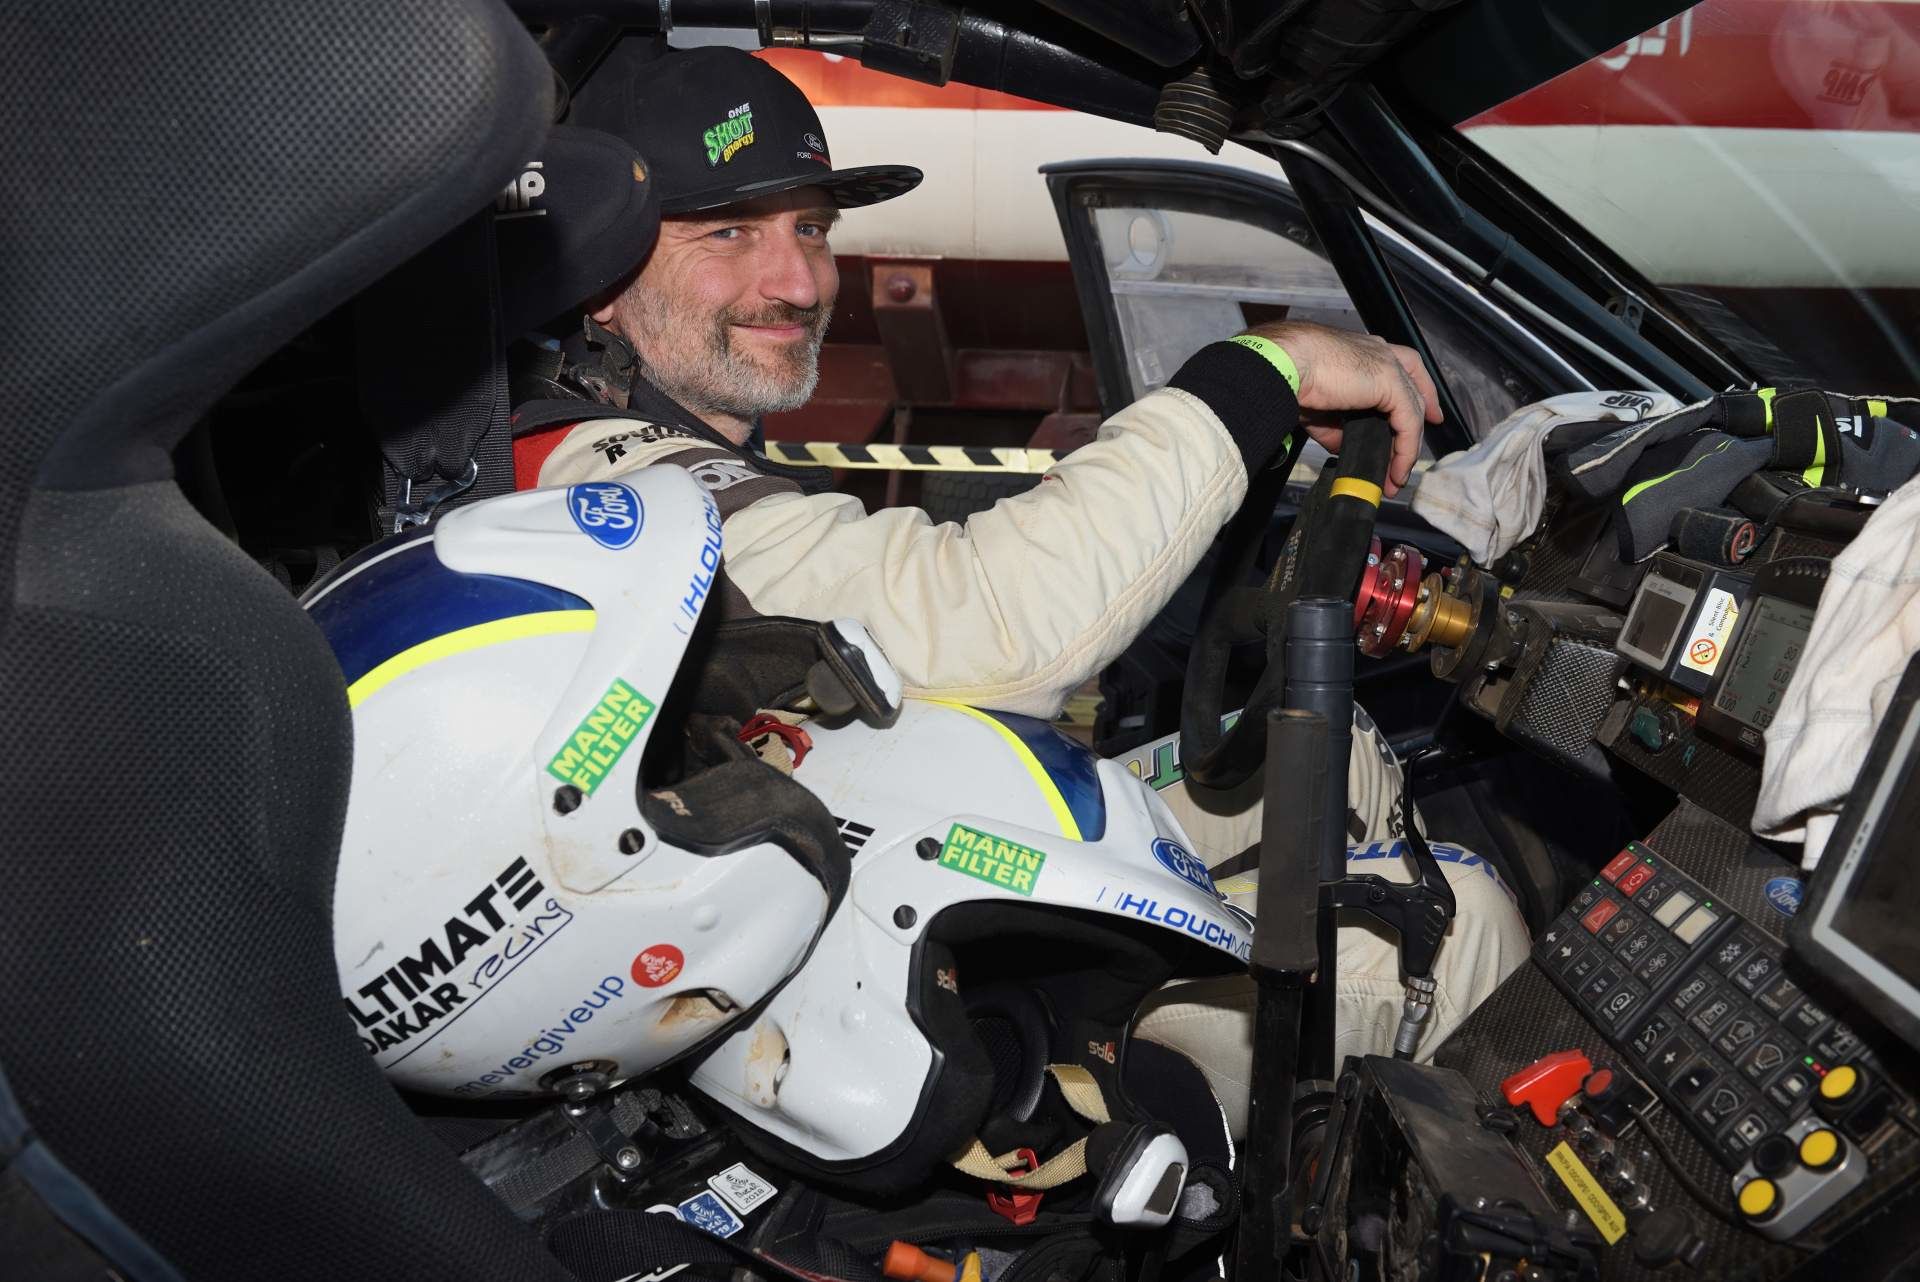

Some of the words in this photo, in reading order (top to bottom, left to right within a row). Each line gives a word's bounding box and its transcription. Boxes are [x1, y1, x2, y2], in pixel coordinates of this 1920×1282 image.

[728, 102, 750, 119] ONE
[703, 112, 753, 167] SHOT
[722, 131, 754, 163] energy
[796, 151, 812, 160] FORD
[577, 486, 634, 530] Ford
[552, 683, 633, 779] MANN
[571, 698, 651, 791] FILTER
[942, 845, 1034, 892] FILTER
[951, 826, 1041, 872] MANN
[344, 855, 545, 1029] LTIMATE
